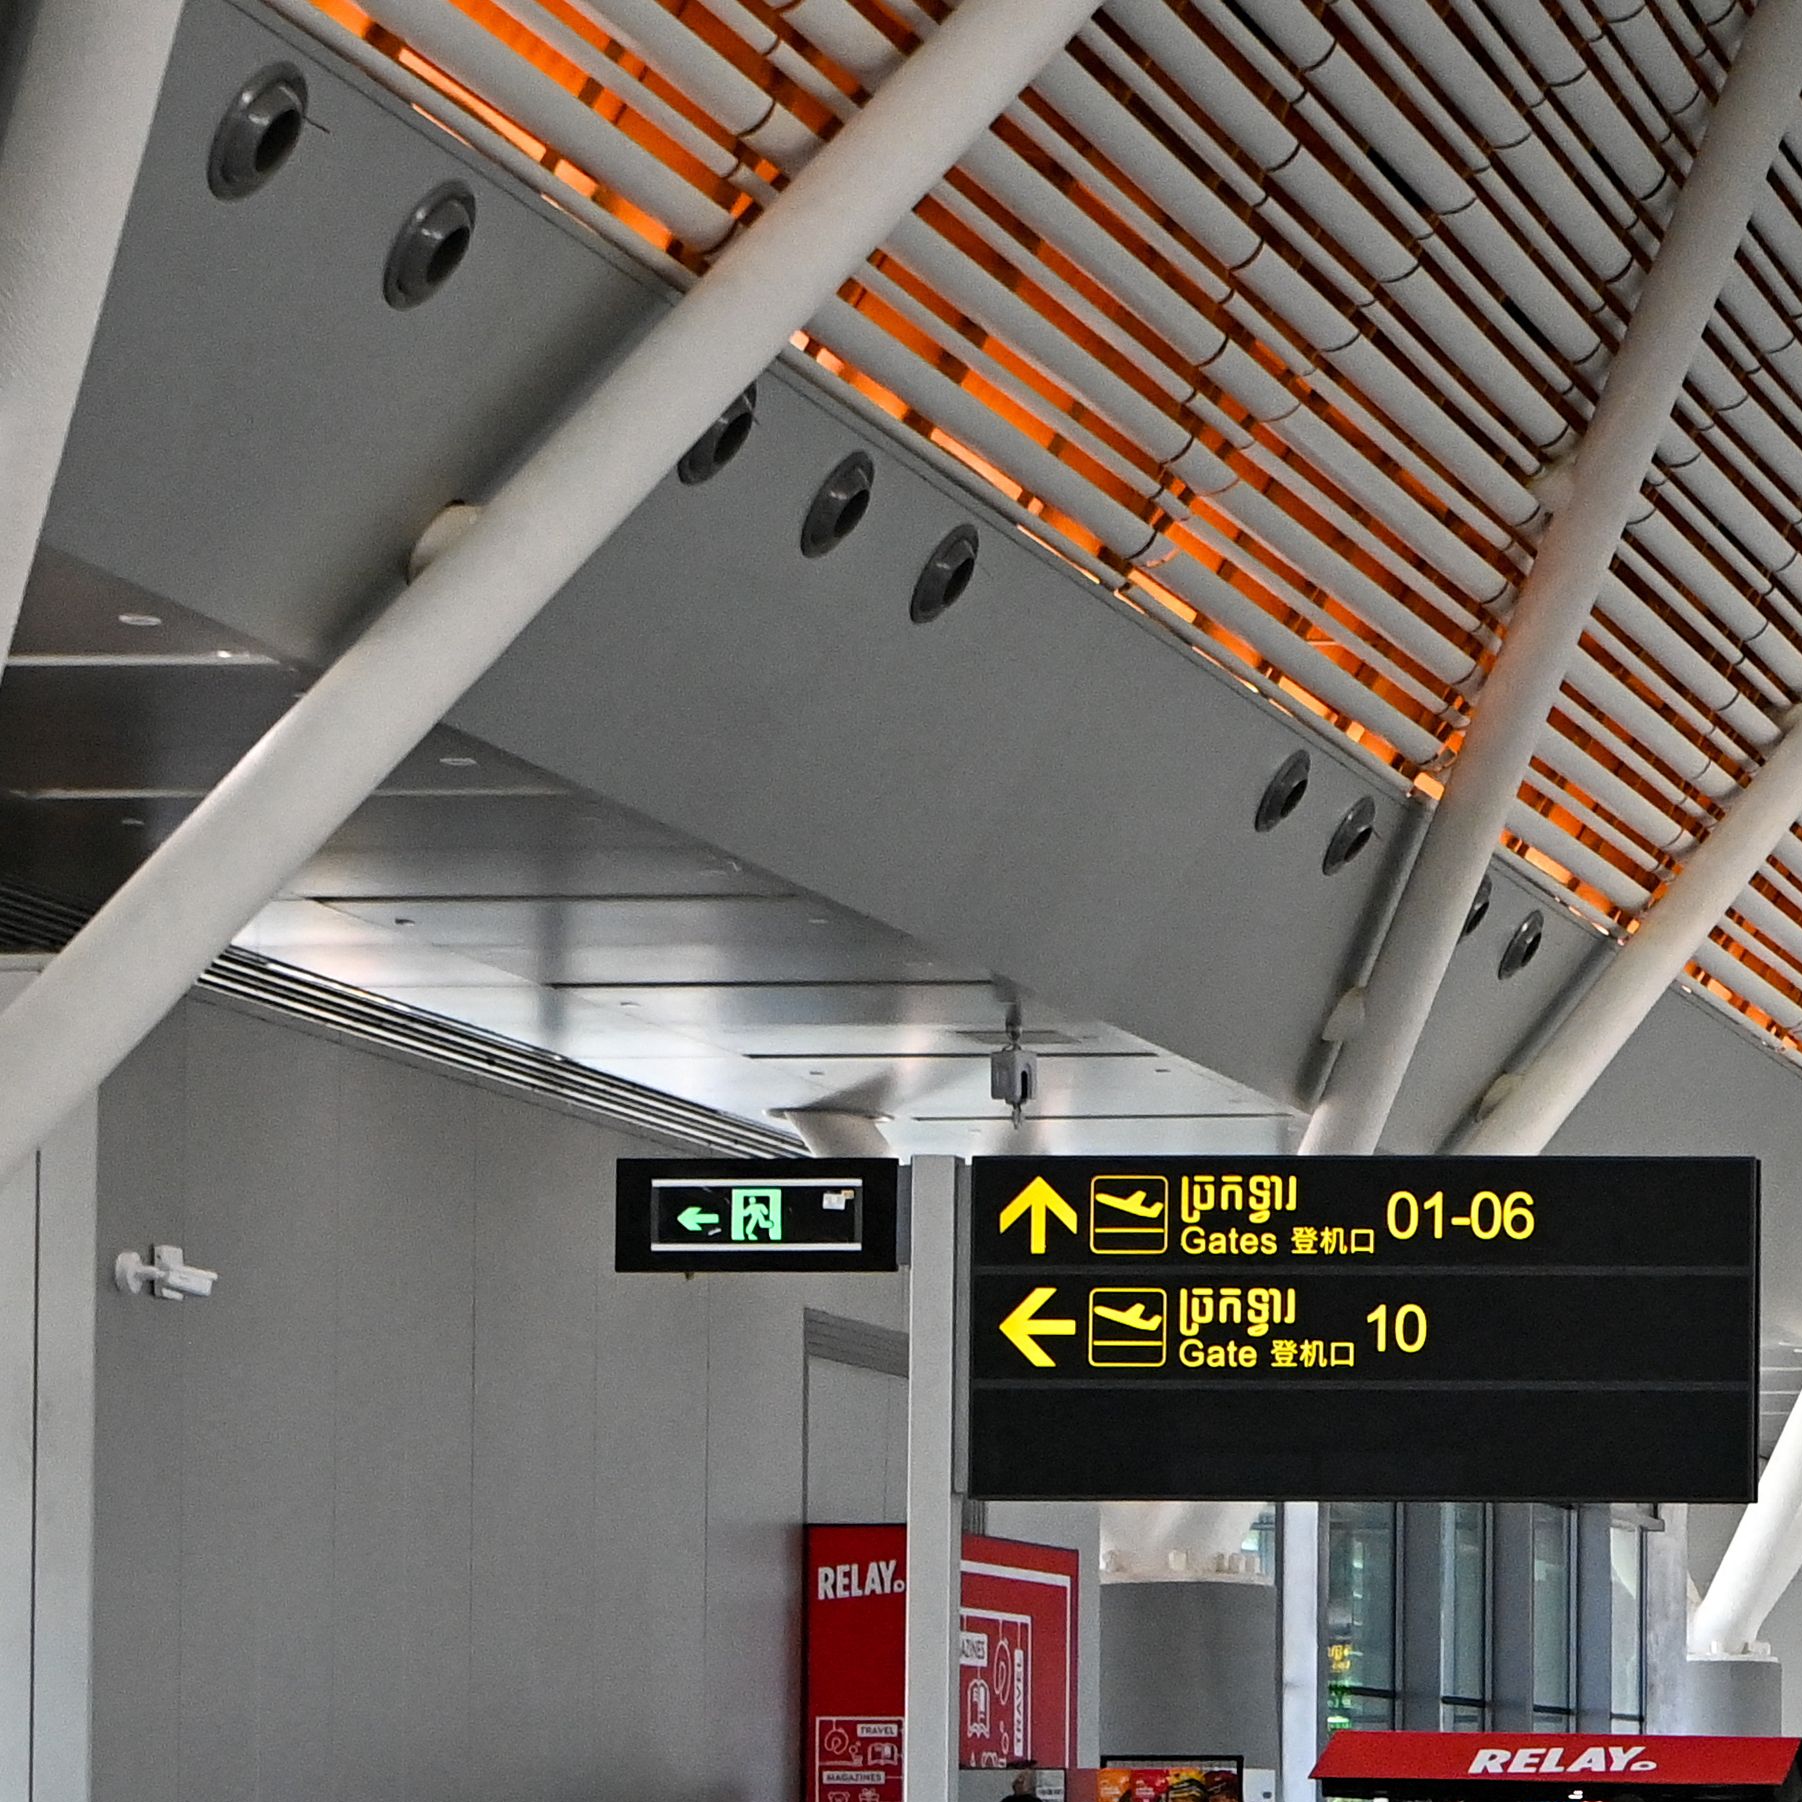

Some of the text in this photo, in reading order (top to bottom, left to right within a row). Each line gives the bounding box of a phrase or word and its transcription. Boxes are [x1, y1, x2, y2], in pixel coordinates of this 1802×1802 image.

[1181, 1191, 1534, 1254] Gates 登机口 01-06
[1180, 1304, 1426, 1367] Gate 登机口 10
[817, 1559, 898, 1601] RELAY
[860, 1726, 895, 1735] TRAVEL
[1467, 1746, 1645, 1774] RELAY
[826, 1774, 882, 1782] MAGAZINES
